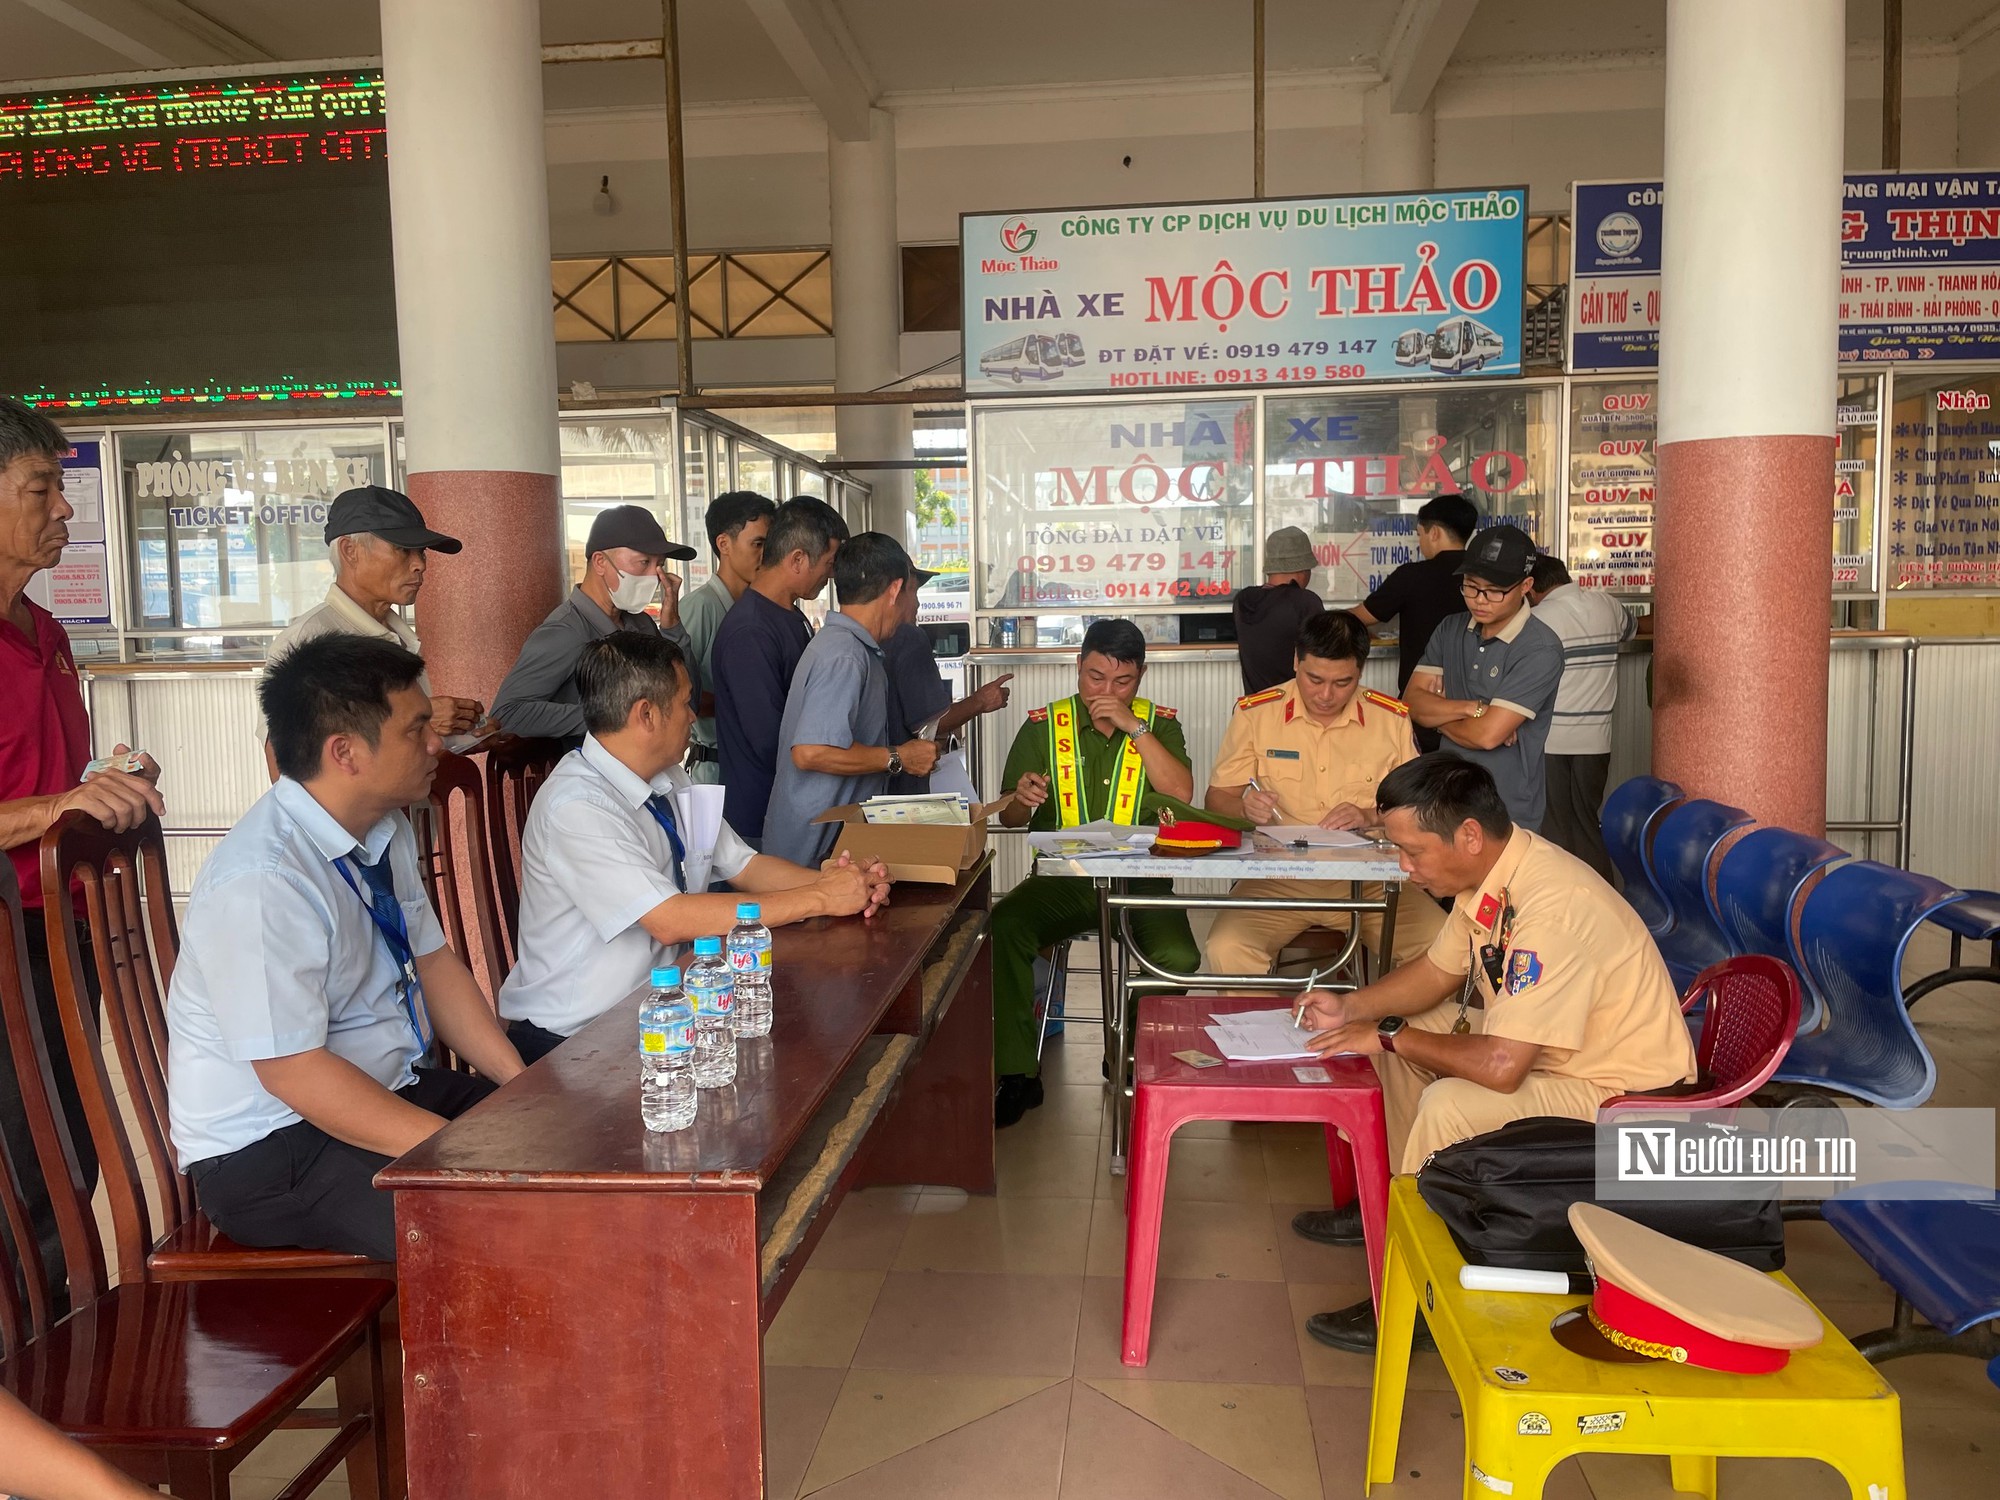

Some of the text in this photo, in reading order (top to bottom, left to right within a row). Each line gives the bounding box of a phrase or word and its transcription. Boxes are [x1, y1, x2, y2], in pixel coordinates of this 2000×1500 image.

[1886, 181, 1928, 200] MẠI
[1935, 178, 1979, 199] VẬN
[1061, 193, 1518, 237] CÔNG TY CP DỊCH VỤ DU LỊCH MỘC THẢO
[1844, 247, 1948, 261] truongthinh.vn
[985, 243, 1498, 333] NHÀ XE MỘC THẢO
[1875, 277, 1893, 293] TP.
[1897, 275, 1926, 292] VINH
[1938, 275, 1978, 292] THANH
[1581, 281, 1603, 325] CẦN
[1607, 289, 1629, 324] THƠ
[1860, 294, 1981, 319] THÁI BÌNH HẢI PHÒNG
[1099, 339, 1378, 365] ĐT ĐẶT VÉ: 0919 479 147
[1110, 364, 1366, 387] HOTLINE: 0913 419 580
[1603, 394, 1650, 411] QUY
[1937, 390, 1990, 413] Nhận
[1110, 412, 1359, 449] NHÀ XE
[1599, 440, 1646, 456] QUY
[136, 450, 228, 498] PHÒNG
[333, 456, 371, 489] XE
[1050, 453, 1225, 514] MỘC
[1296, 434, 1527, 499] THẢO
[1585, 488, 1631, 503] QUY
[1951, 495, 1971, 511] Qua
[170, 505, 253, 528] TICKET
[1026, 522, 1224, 545] TỔNG ĐÀI ĐẶT VÉ
[1602, 533, 1648, 548] QUY
[1017, 550, 1237, 574] 0919 479 147
[1370, 546, 1388, 566] TUY
[1391, 541, 1413, 565] HÒA:
[1020, 580, 1231, 601] Hotline: 0914 742 668
[1579, 572, 1598, 589] ĐẶT
[1601, 573, 1617, 587] VÉ:
